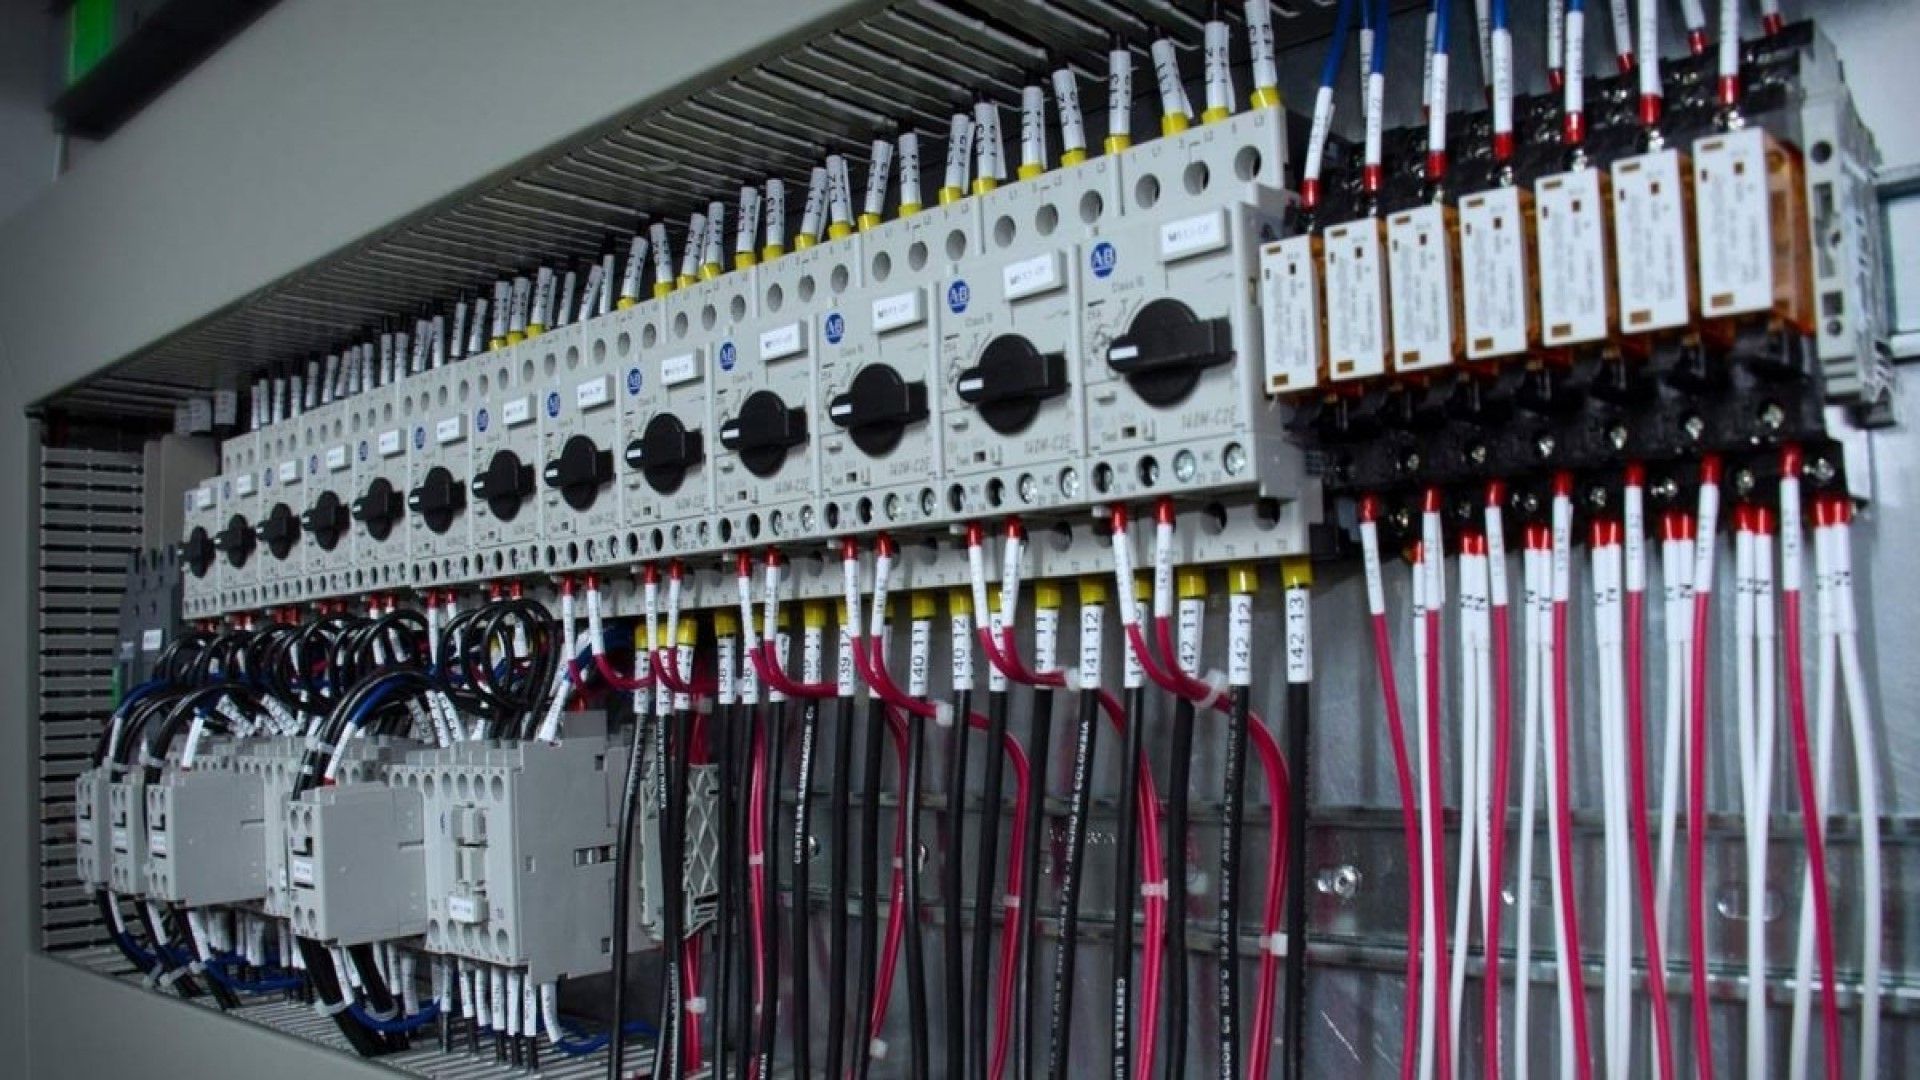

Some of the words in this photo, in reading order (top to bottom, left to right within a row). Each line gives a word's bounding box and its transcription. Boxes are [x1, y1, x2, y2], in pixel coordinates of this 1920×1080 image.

[1092, 244, 1116, 274] AB
[949, 283, 969, 311] AB
[1085, 612, 1099, 634] 12
[1182, 608, 1196, 630] 11
[1288, 597, 1305, 622] 13
[912, 628, 923, 646] 11
[953, 618, 966, 639] 12
[953, 647, 966, 680] 140
[1084, 647, 1098, 680] 141
[1235, 636, 1249, 672] 142
[1289, 633, 1305, 671] 142
[913, 655, 925, 686] 140
[1074, 720, 1089, 791] COLOMBIA
[1115, 977, 1126, 1049] CENTELSA
